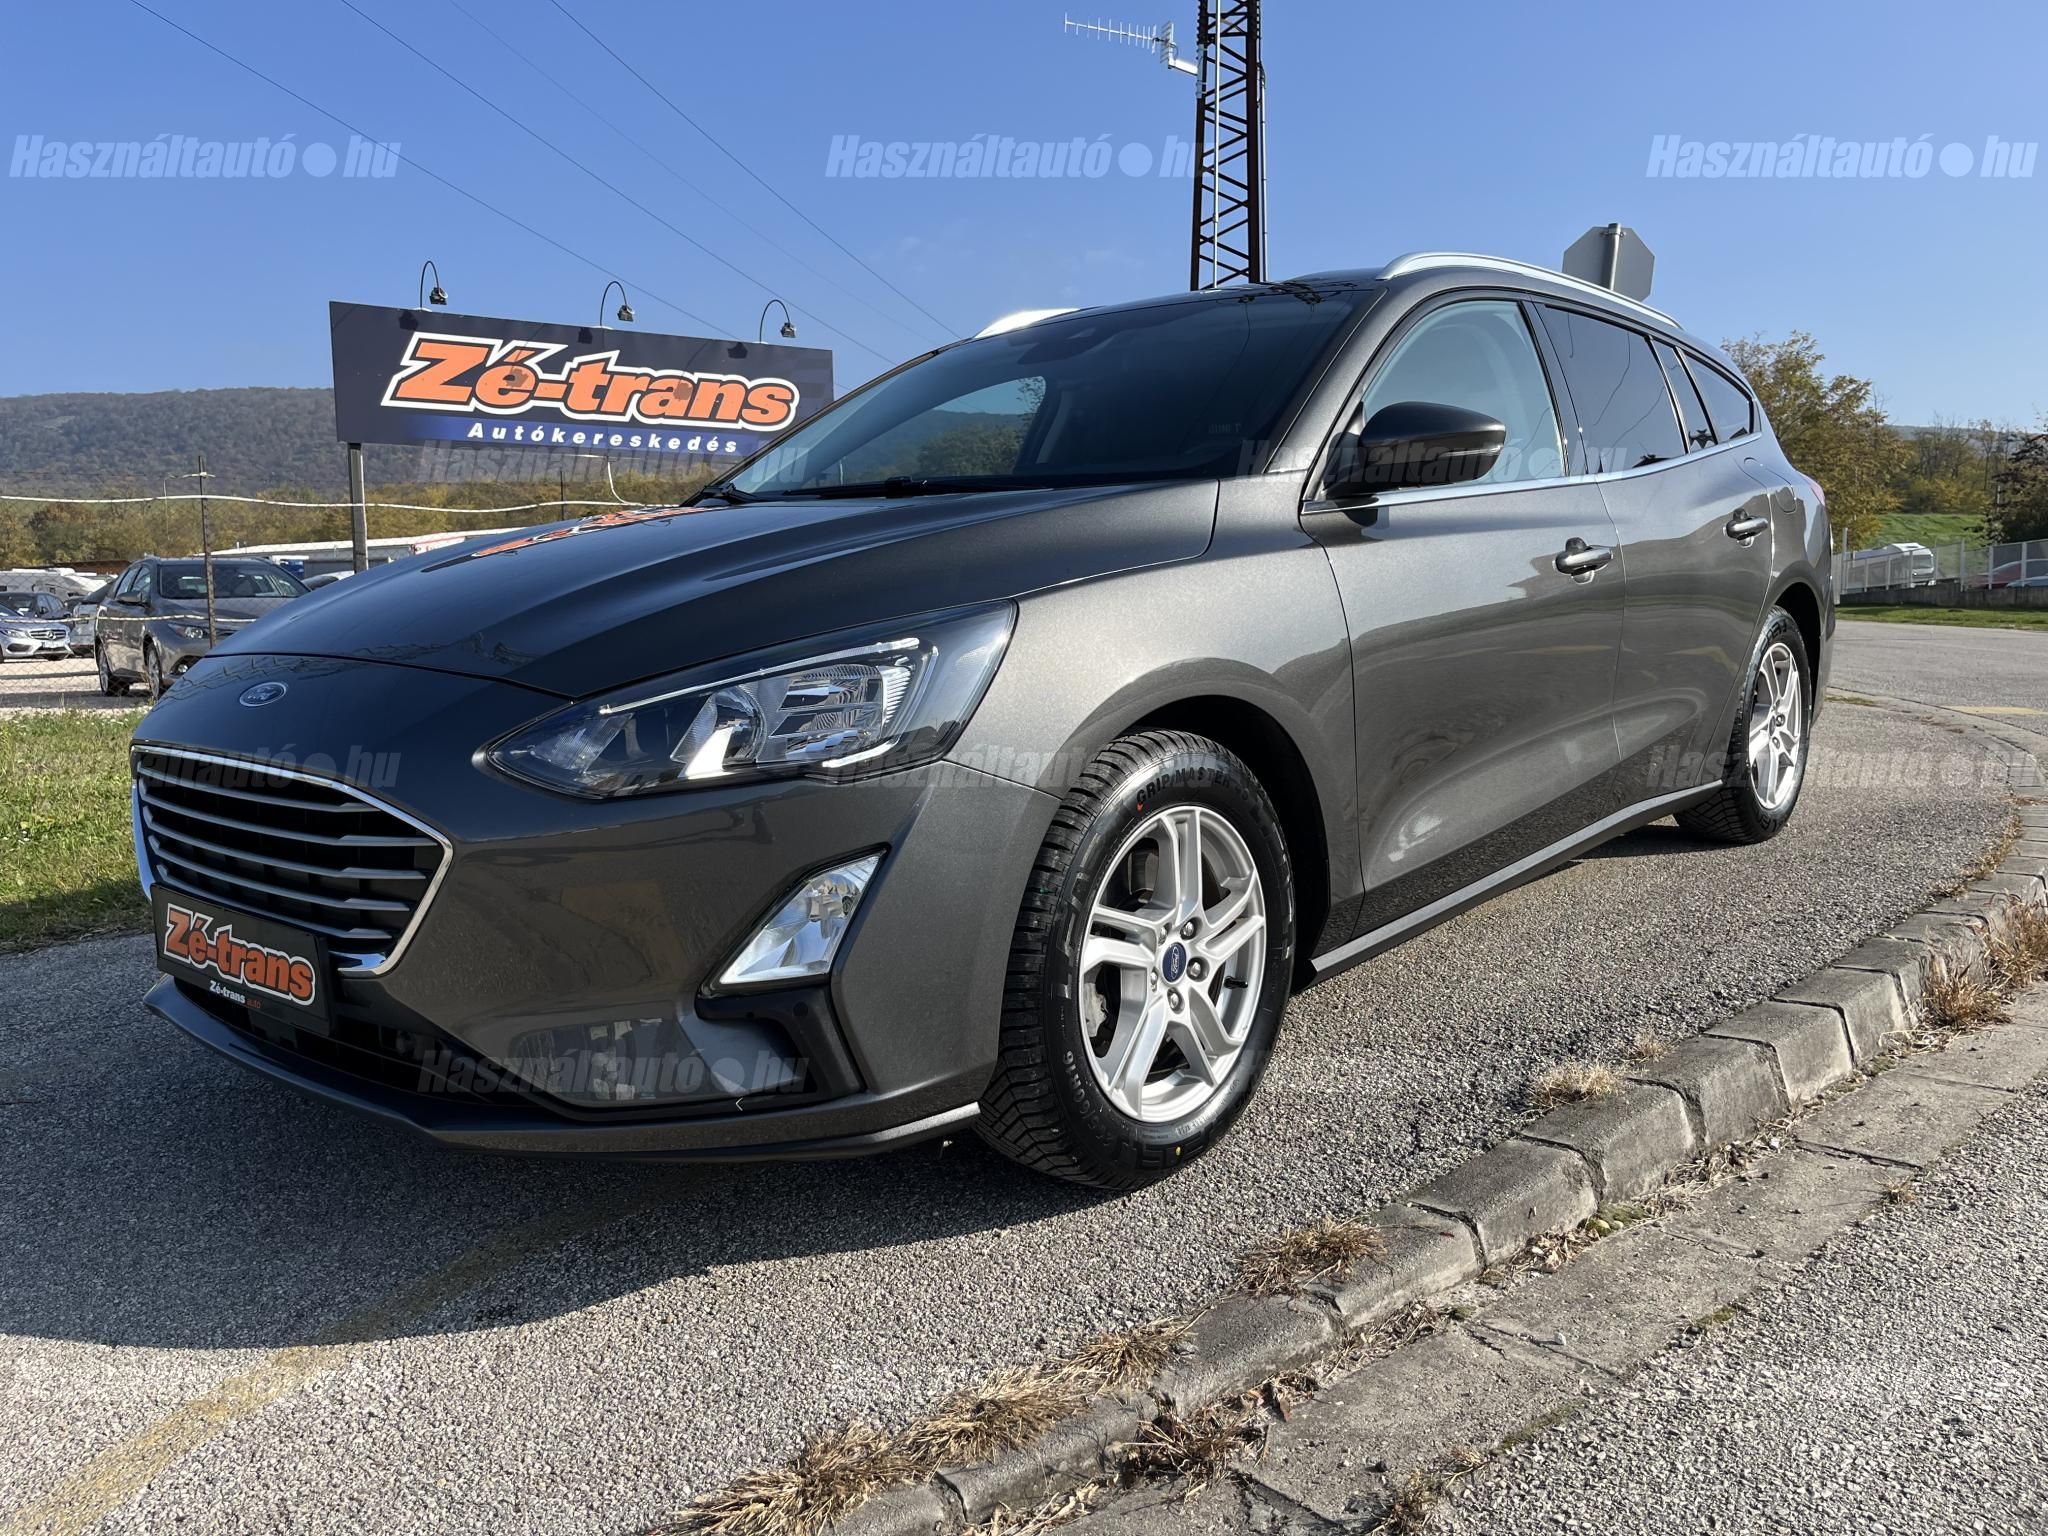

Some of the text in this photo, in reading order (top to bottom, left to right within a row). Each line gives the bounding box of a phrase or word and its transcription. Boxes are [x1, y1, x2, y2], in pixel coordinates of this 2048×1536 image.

[385, 334, 799, 429] Zé-trans
[468, 422, 738, 453] Autókereskedés
[165, 905, 314, 1003] Zé-trans
